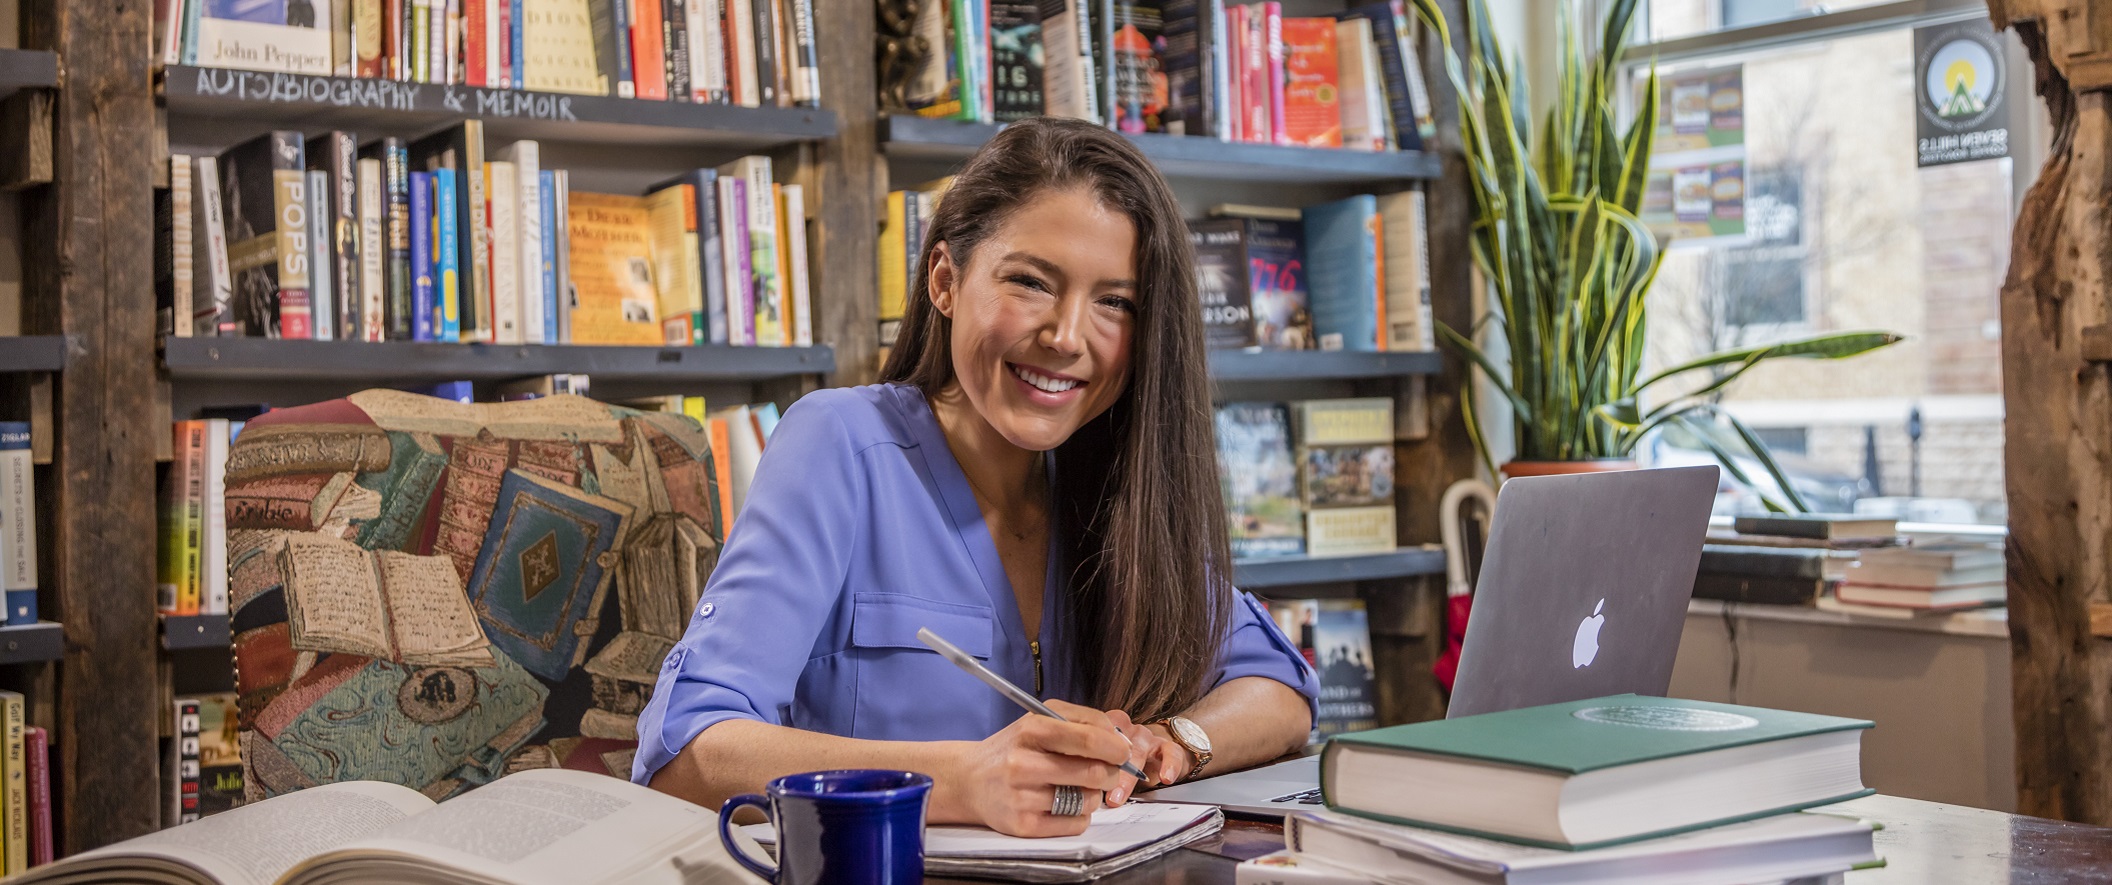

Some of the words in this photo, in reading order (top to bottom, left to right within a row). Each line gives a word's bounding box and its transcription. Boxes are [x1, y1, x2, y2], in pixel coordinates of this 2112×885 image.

[213, 39, 259, 62] John
[263, 44, 326, 69] Pepper
[443, 85, 467, 113] &
[477, 90, 578, 122] MEMOIR
[470, 170, 485, 205] BOB
[281, 181, 308, 275] POPS
[471, 208, 488, 265] DYLAN
[1, 432, 31, 443] ZIGLAR
[13, 456, 24, 495] SECRETS
[14, 507, 25, 544] CLOSING
[17, 561, 27, 583] SALE
[10, 703, 22, 723] Golf
[10, 743, 21, 761] Way
[11, 788, 22, 804] JACK
[11, 807, 23, 840] NICKLAUS
